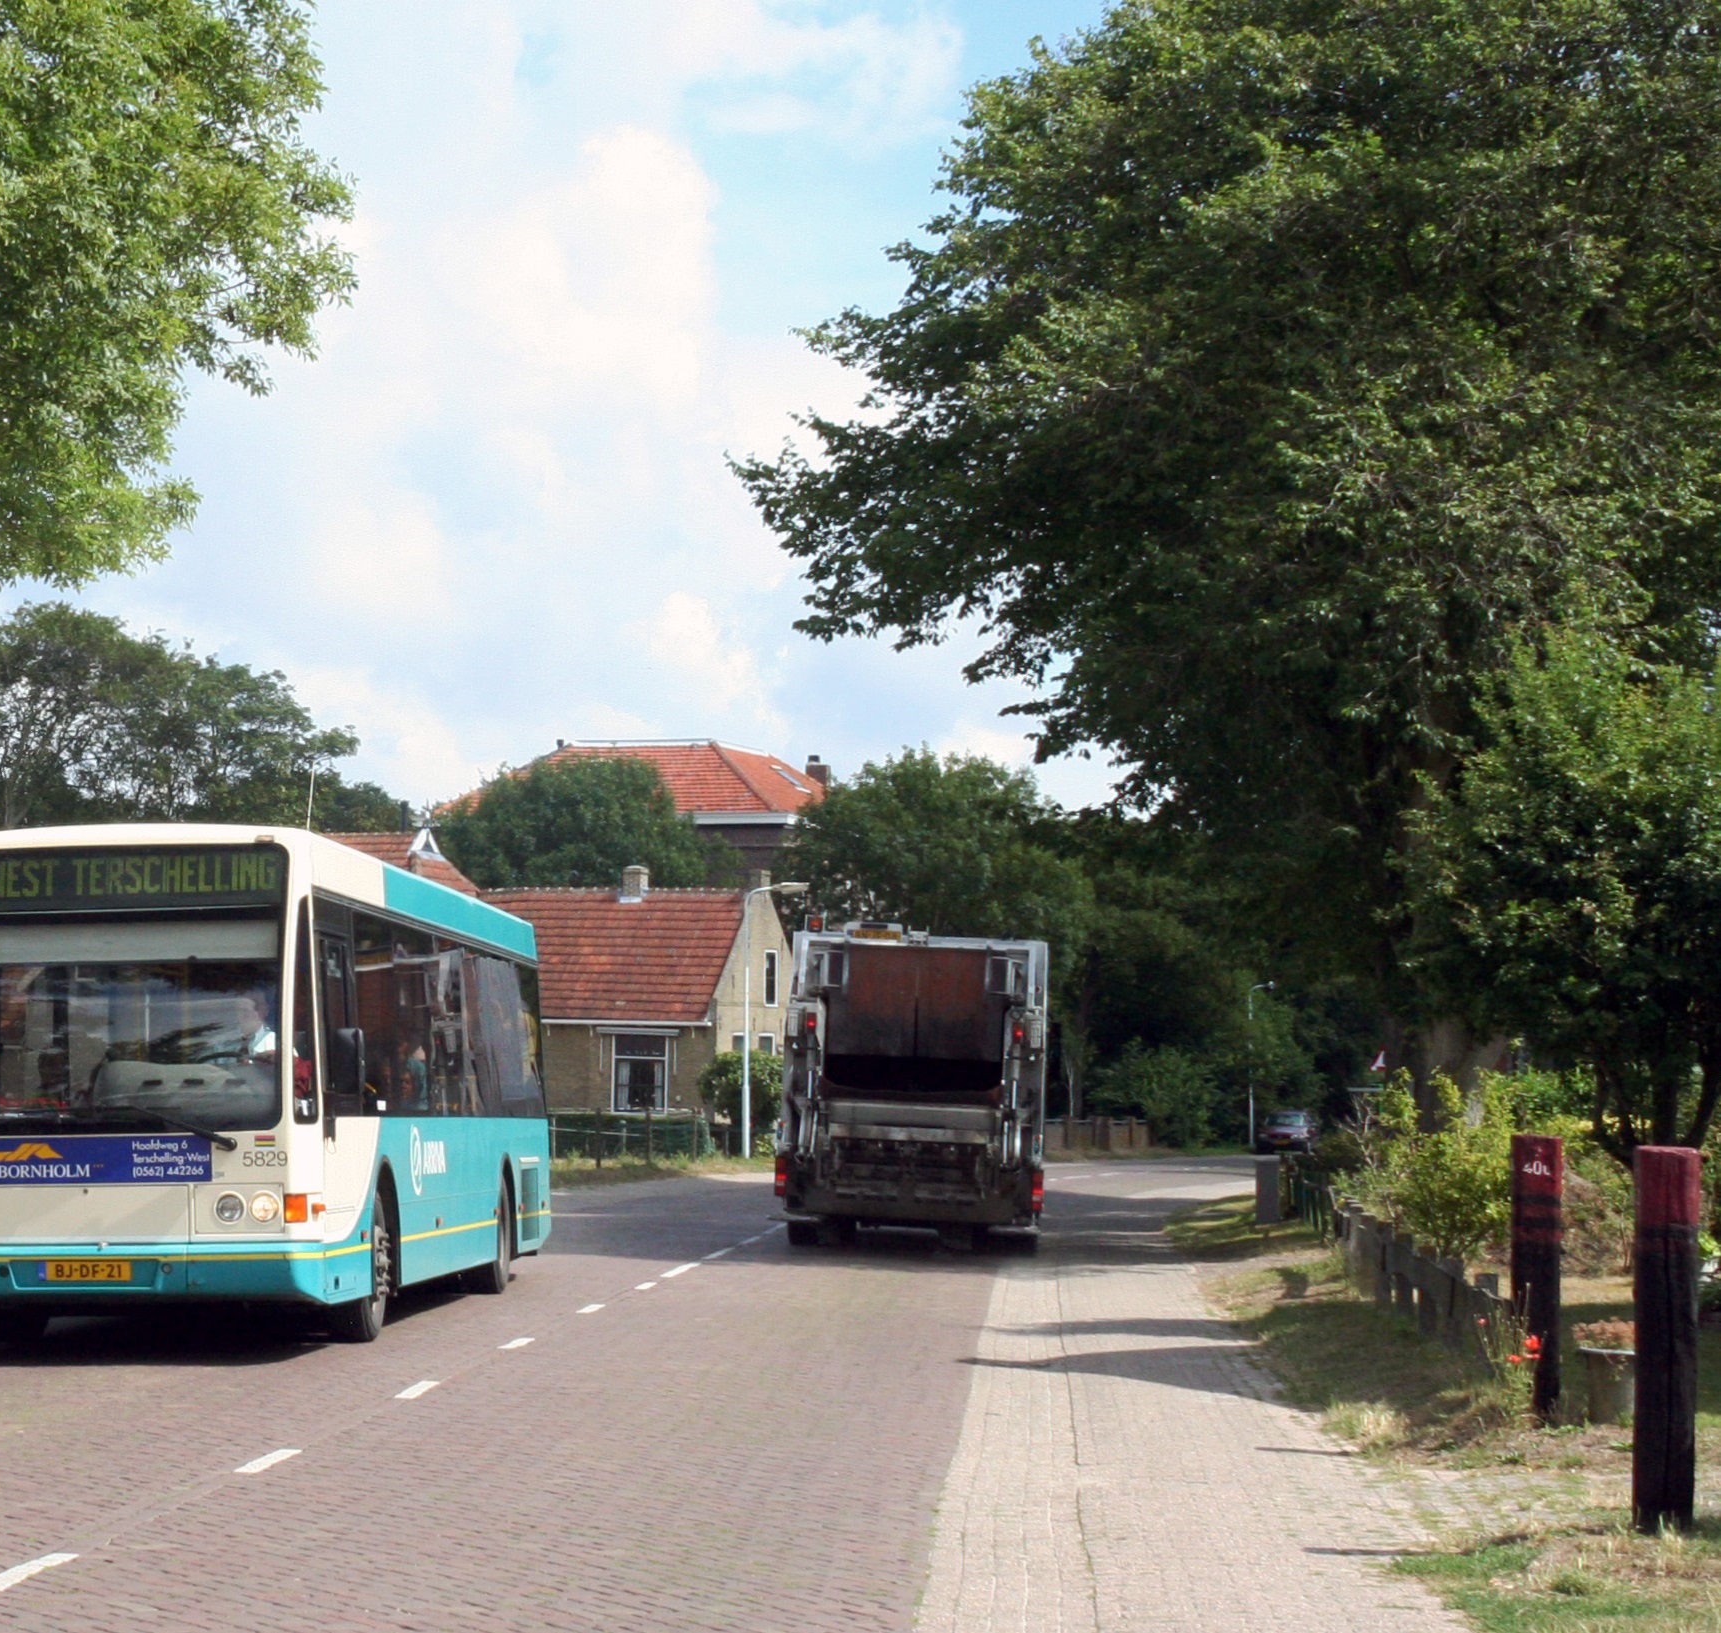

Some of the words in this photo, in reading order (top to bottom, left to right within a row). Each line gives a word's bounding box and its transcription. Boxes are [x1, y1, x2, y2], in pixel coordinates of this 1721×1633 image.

[72, 853, 276, 896] TERSCHELLING
[131, 1139, 179, 1151] Hoofdweg
[180, 1140, 188, 1150] 6
[132, 1152, 210, 1165] Terschelling-West
[242, 1151, 288, 1167] 5829
[132, 1166, 164, 1178] (0562)
[166, 1165, 204, 1176] 442266
[54, 1263, 122, 1279] BJ-DF-21
